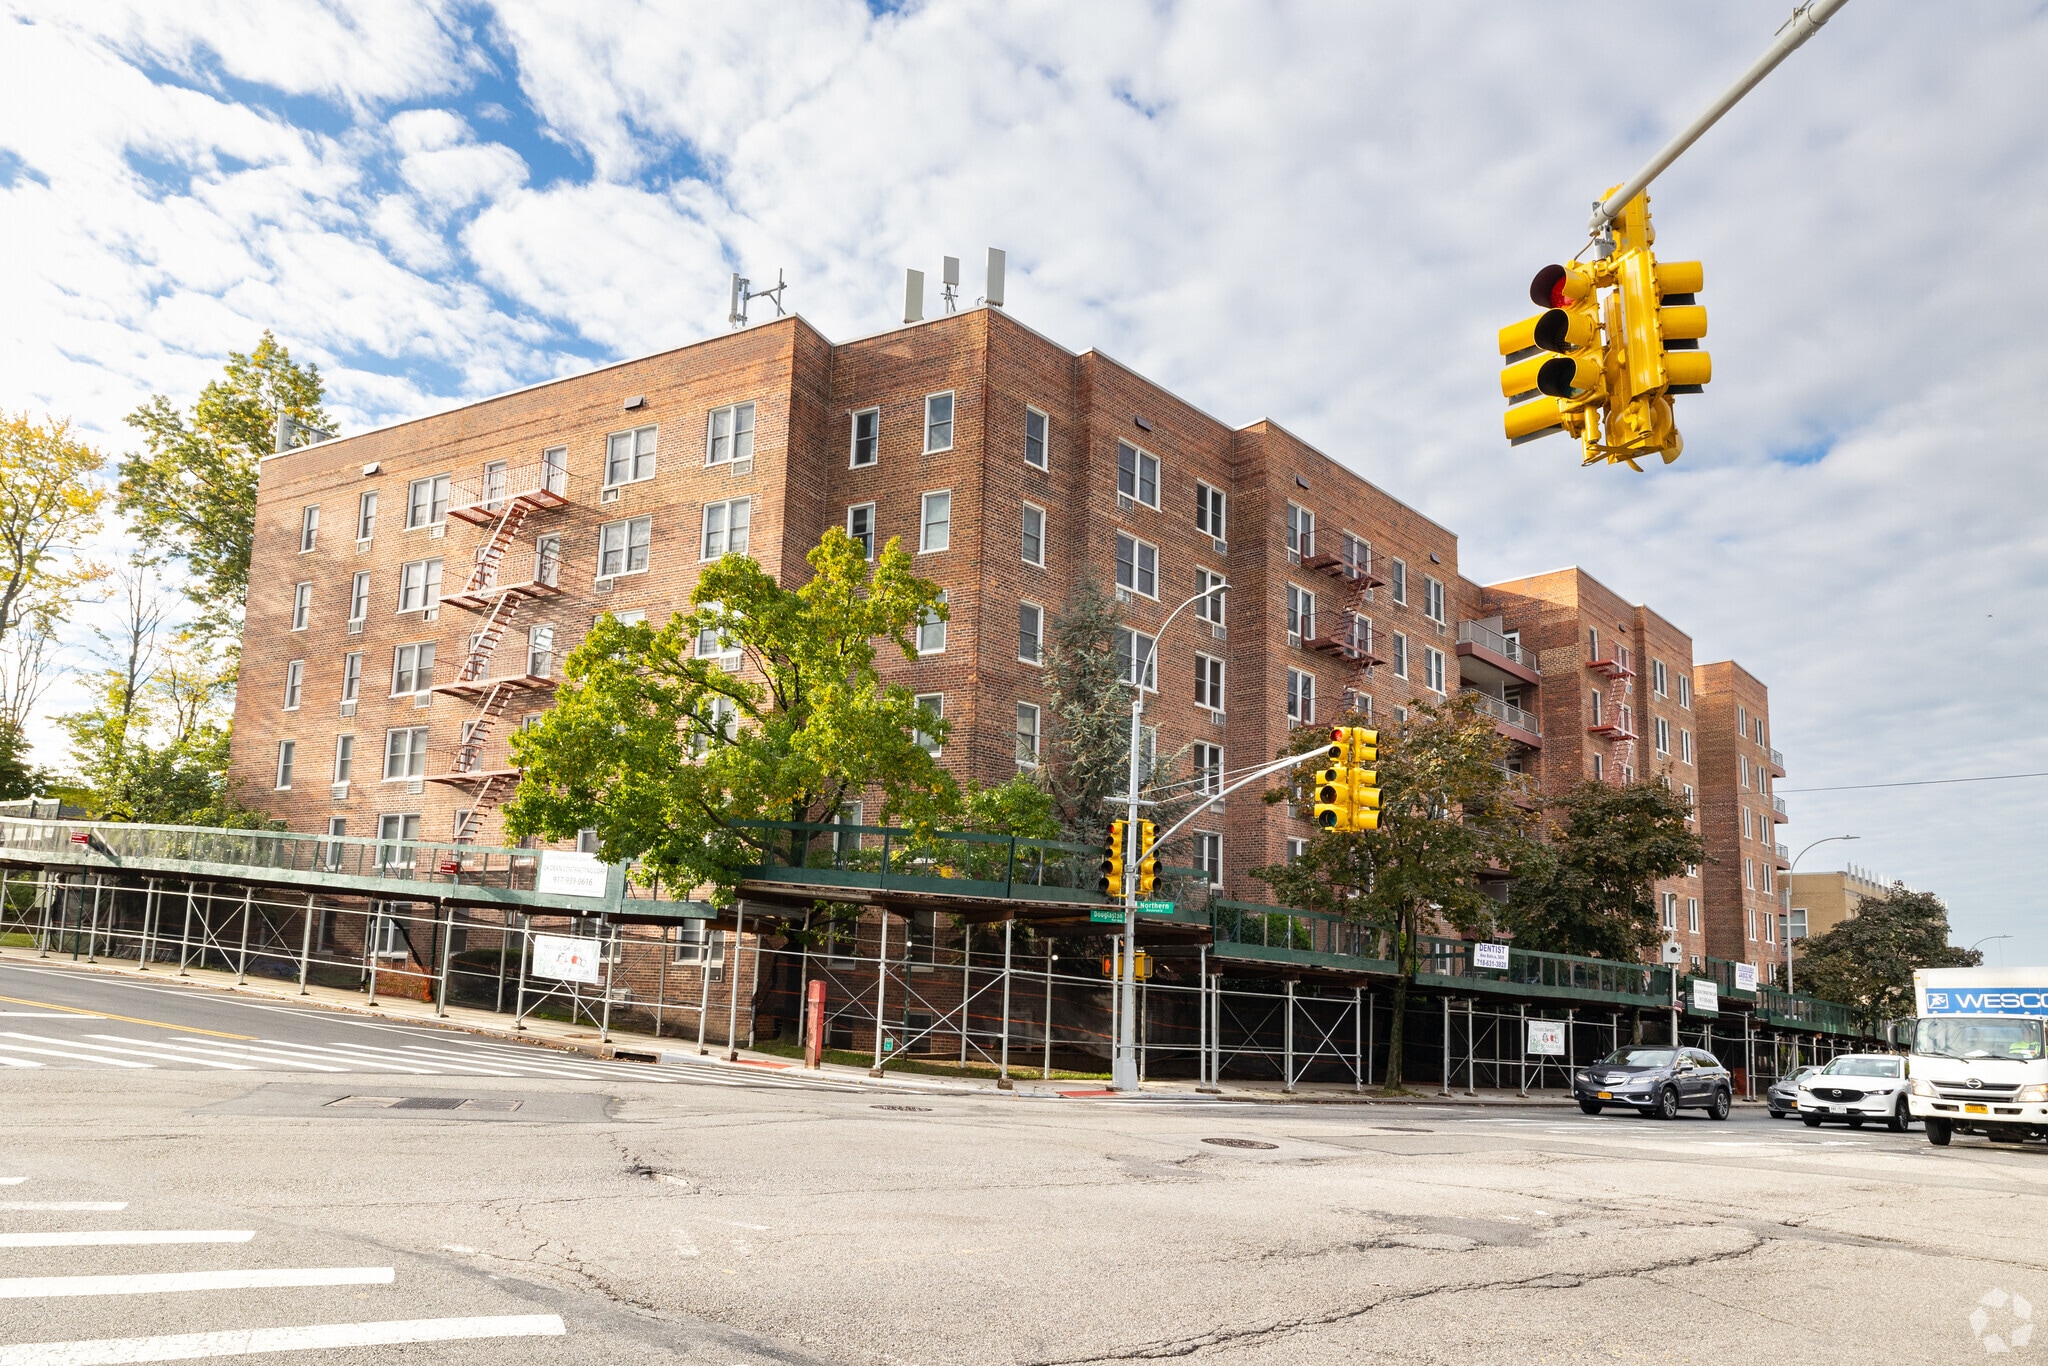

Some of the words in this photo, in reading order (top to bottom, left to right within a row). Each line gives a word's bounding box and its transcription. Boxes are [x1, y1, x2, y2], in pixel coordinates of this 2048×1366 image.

[562, 865, 594, 874] CONTRACTING
[1093, 911, 1123, 920] Douglaston
[1479, 943, 1506, 954] DENTIST
